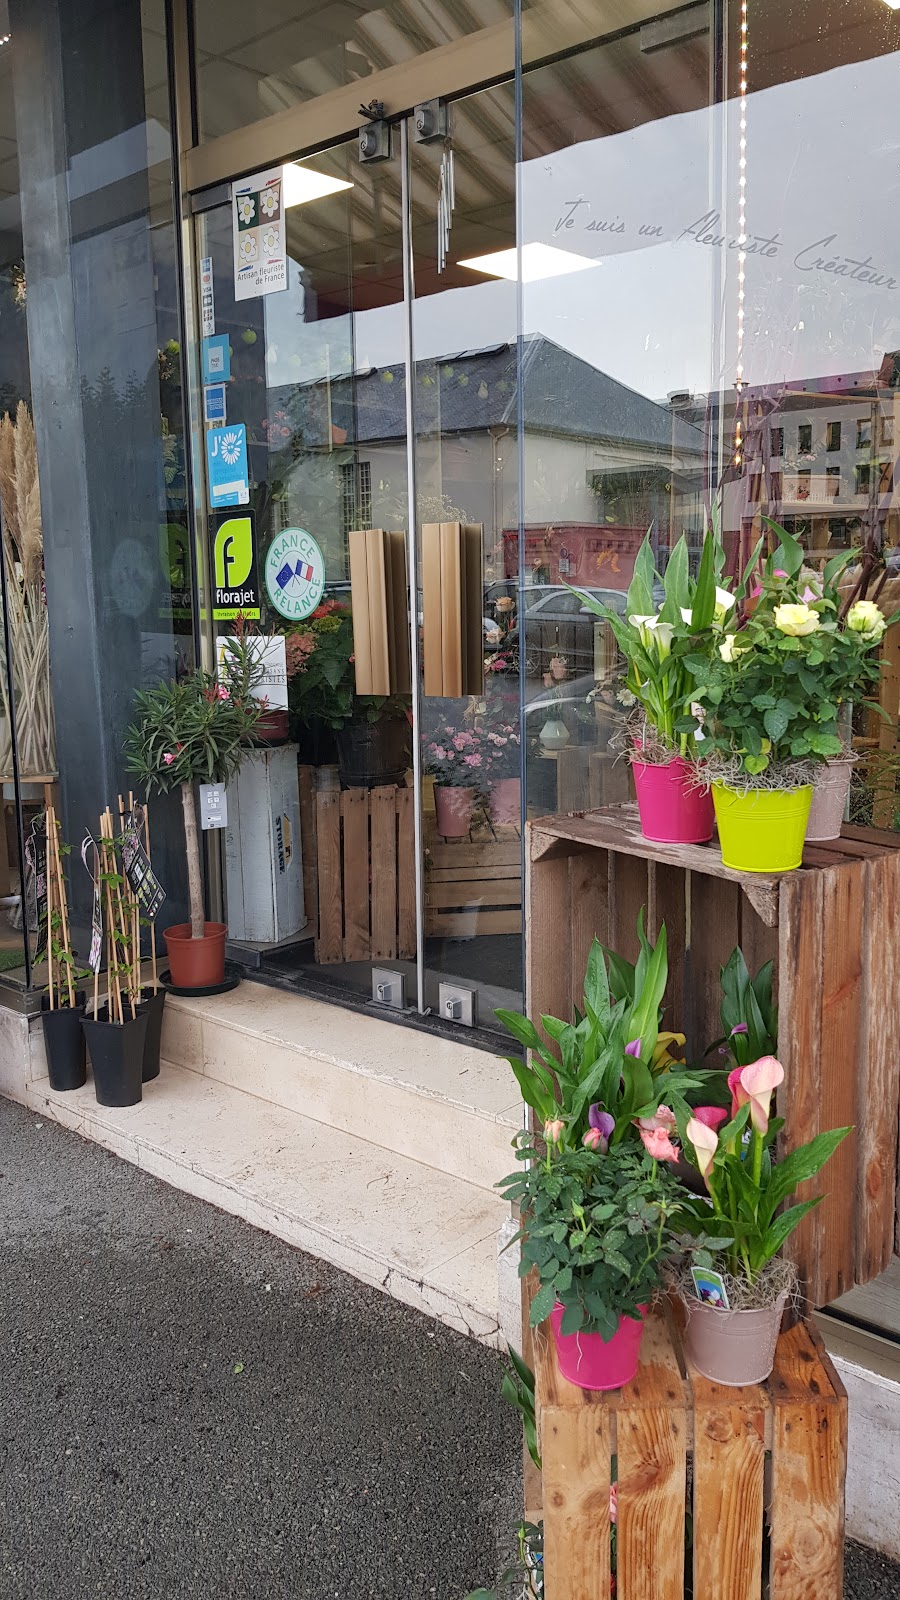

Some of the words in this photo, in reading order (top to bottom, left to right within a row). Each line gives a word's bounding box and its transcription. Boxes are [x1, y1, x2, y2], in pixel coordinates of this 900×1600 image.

[555, 198, 590, 232] Je
[585, 216, 626, 233] suis
[638, 224, 664, 237] un
[794, 233, 899, 290] Créateur
[237, 271, 258, 282] Artisan
[259, 264, 285, 276] fleuriste
[255, 277, 263, 286] de
[264, 273, 285, 283] France
[270, 534, 315, 568] FRANCE
[216, 588, 256, 607] florajet
[274, 577, 321, 614] RELANCE
[275, 815, 286, 875] STORAGE
